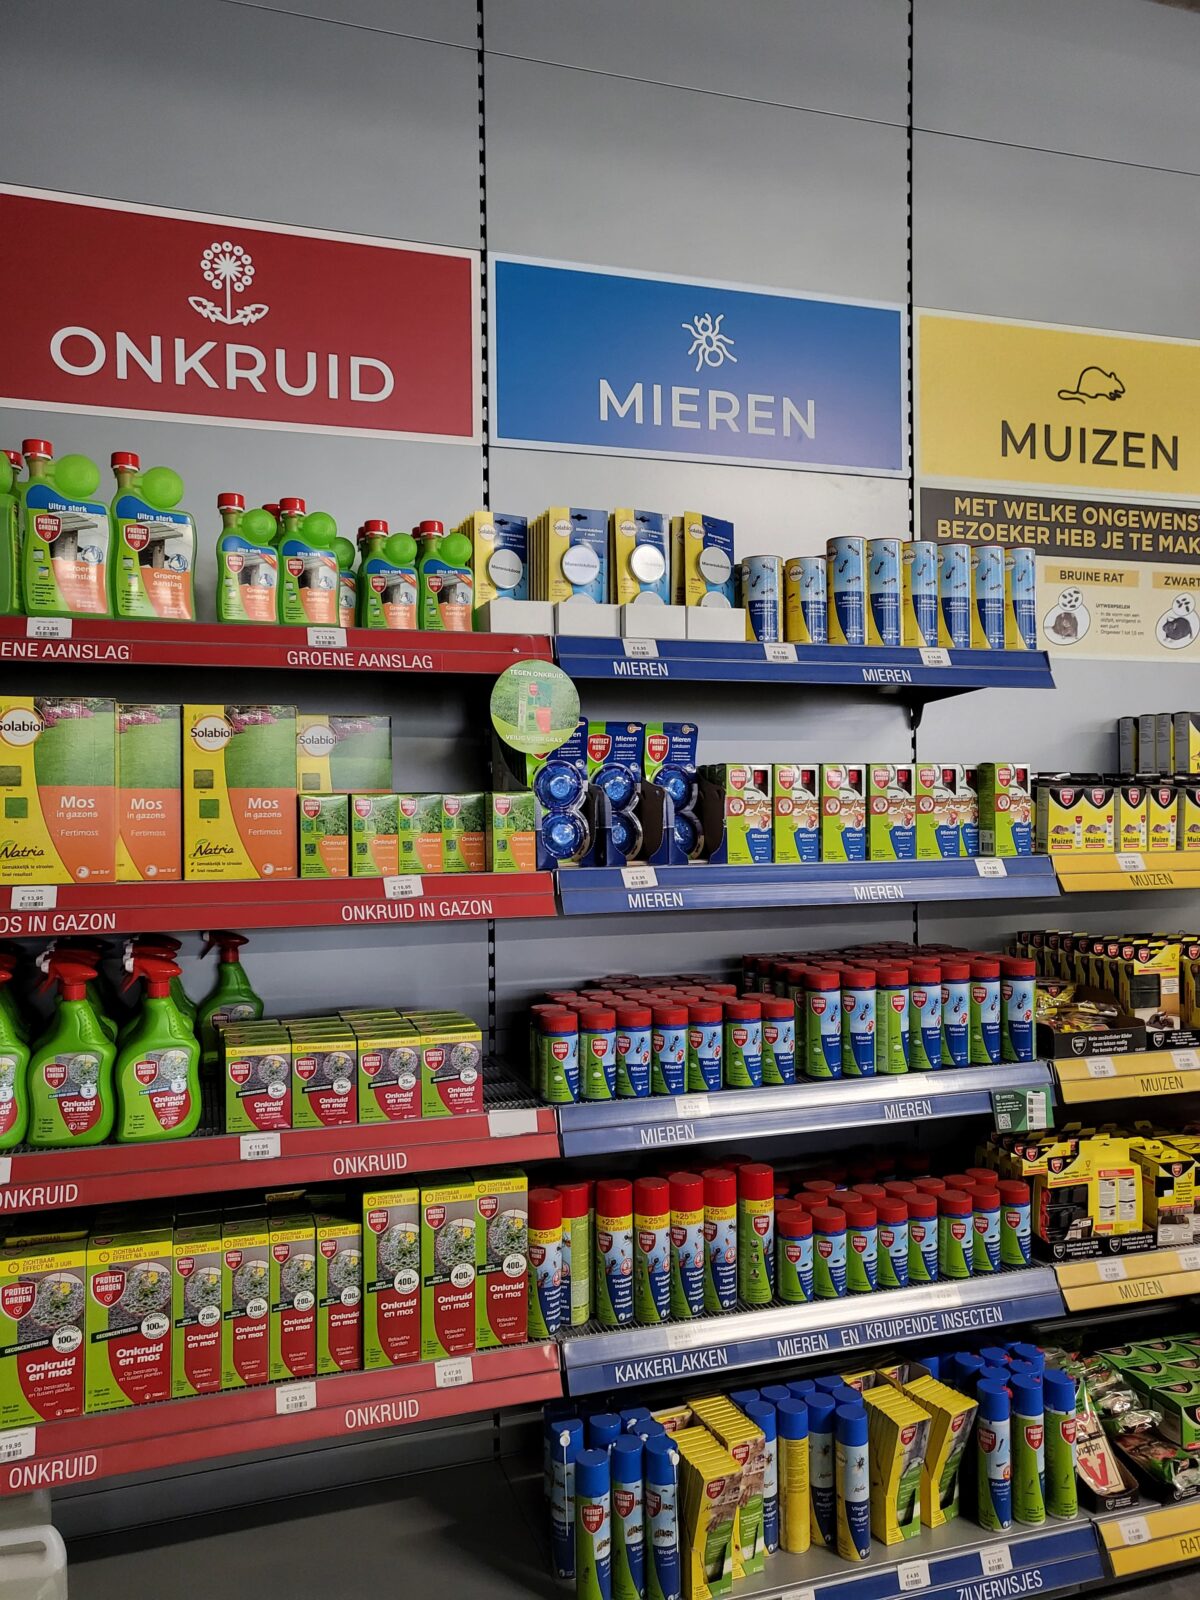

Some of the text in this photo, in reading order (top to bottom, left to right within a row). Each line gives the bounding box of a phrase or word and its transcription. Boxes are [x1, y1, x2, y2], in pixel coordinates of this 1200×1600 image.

[50, 326, 395, 402] ONKRUID
[600, 379, 816, 439] MIEREN
[1001, 420, 1179, 472] MUIZEN
[48, 502, 88, 513] Ultra sterk
[136, 512, 174, 523] Ultra sterk
[954, 497, 1200, 532] MET WELKE ONGEWENS
[937, 519, 1050, 545] BEZOEKER
[1056, 528, 1096, 548] HEB
[1101, 531, 1123, 550] JE
[1129, 533, 1153, 552] TE
[154, 572, 182, 581] Groene
[1060, 570, 1125, 583] BRUINE RAT
[152, 580, 182, 590] aanslag
[1, 642, 129, 660] ENE AANSLAG
[287, 651, 433, 669] GROENE AANSLAG
[510, 669, 564, 679] TEGEN ONKRUID
[613, 661, 668, 677] MIEREN
[862, 668, 912, 682] MIEREN
[191, 727, 233, 738] Solabiol
[616, 735, 638, 743] Mieren
[300, 735, 337, 745] Solabiol
[60, 796, 95, 809] Mos
[131, 798, 163, 810] Mos
[248, 798, 279, 809] Mos
[56, 810, 98, 820] in gazons
[126, 812, 166, 821] in gazons
[244, 810, 282, 820] in gazons
[60, 828, 98, 837] Fertimoss
[130, 830, 166, 838] Fertimoss
[248, 828, 282, 836] Fertimoss
[1, 843, 45, 860] Natria
[193, 842, 234, 857] Natria
[1130, 873, 1173, 887] MUIZEN
[854, 885, 904, 900] MIEREN
[628, 892, 683, 908] MIEREN
[341, 900, 493, 921] ONKRUID IN GAZON
[28, 915, 47, 932] IN
[52, 913, 116, 931] GAZON
[1141, 1075, 1184, 1092] MUIZEN
[61, 1100, 96, 1108] Onkruid
[152, 1094, 186, 1104] Onkruid
[154, 1100, 165, 1108] en
[884, 1100, 932, 1120] MIEREN
[640, 1124, 695, 1145] MIEREN
[333, 1152, 408, 1175] ONKRUID
[0, 1184, 78, 1209] NKRUID
[112, 1246, 144, 1256] ZICHTBAAR
[112, 1254, 133, 1262] EFFECT
[148, 1250, 160, 1258] UUR
[22, 1256, 56, 1266] ZICHTBAAR
[22, 1264, 45, 1272] EFFECT
[96, 1275, 123, 1284] PROTECT
[4, 1286, 32, 1296] PROTECT
[96, 1283, 121, 1292] GARDEN
[1118, 1281, 1164, 1299] MUIZEN
[5, 1295, 31, 1305] GARDEN
[283, 1317, 313, 1326] Onkruid
[96, 1326, 139, 1340] GECONCENTREERD
[235, 1324, 266, 1334] Onkruid
[777, 1306, 1003, 1357] MIEREN EN KRUIPENDE INSECTEN
[187, 1332, 219, 1342] Onkruid
[200, 1339, 216, 1347] mos
[4, 1339, 49, 1354] GECONCENTREERD
[116, 1343, 164, 1358] Onkruid
[26, 1357, 76, 1373] Onkruid
[118, 1354, 161, 1367] en mos
[615, 1348, 728, 1384] KAKKERLAKKEN
[29, 1368, 73, 1381] en mos
[345, 1399, 419, 1429] ONKRUID
[5, 1442, 22, 1450] 19,95
[9, 1455, 97, 1488] ONKRUID
[956, 1570, 1043, 1600] ZILVERVISJES
